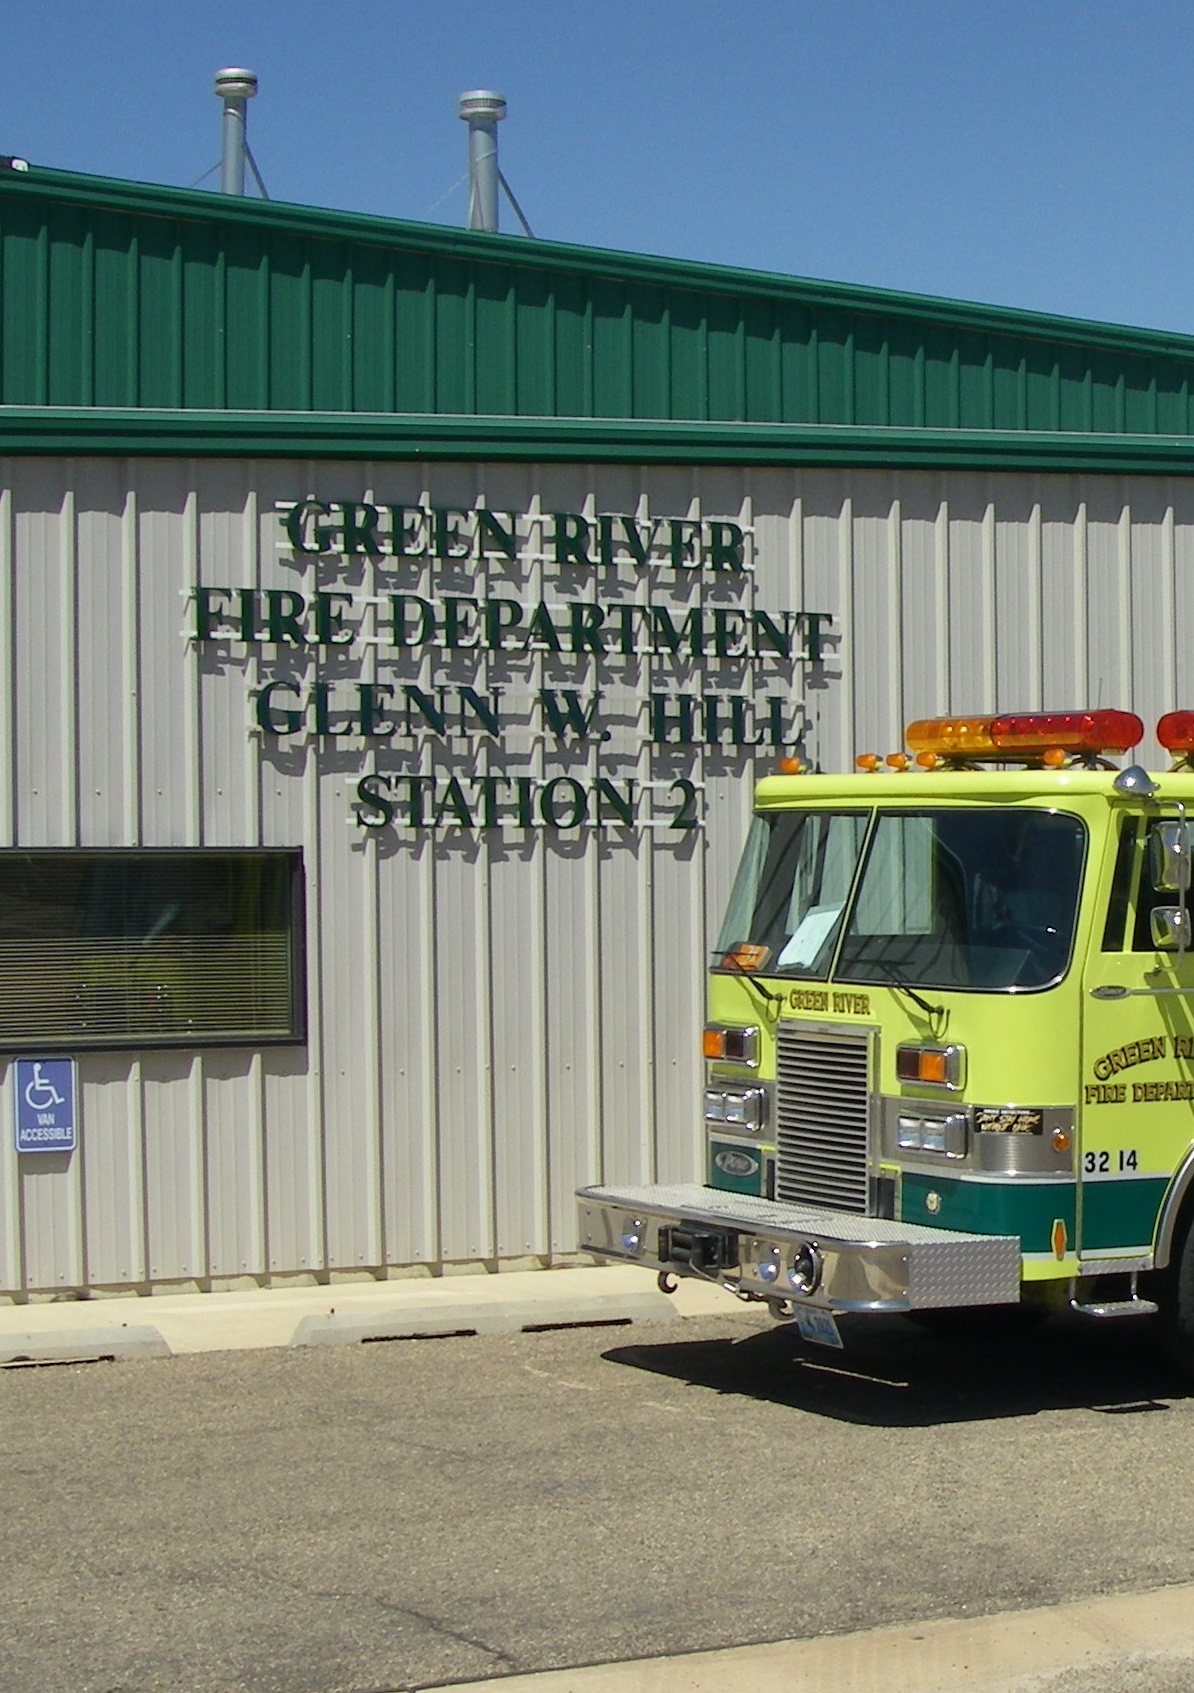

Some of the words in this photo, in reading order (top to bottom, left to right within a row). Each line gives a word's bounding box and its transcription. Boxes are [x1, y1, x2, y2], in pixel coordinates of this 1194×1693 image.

[286, 500, 518, 562] GREEN
[553, 511, 747, 572] RIVER
[194, 586, 355, 646] FIRE
[388, 594, 834, 662] DEPARTMENT
[255, 681, 502, 738] GLENN
[538, 689, 613, 742] W.
[649, 693, 804, 746] HILL
[355, 775, 637, 829] STATION
[671, 779, 698, 830] 2
[789, 988, 829, 1012] GREEN
[832, 991, 871, 1016] RIVER
[1093, 1036, 1167, 1081] GREEN
[1084, 1083, 1127, 1105] FIRE
[21, 1127, 72, 1141] ACCESSIBLE
[37, 1113, 56, 1126] VAN
